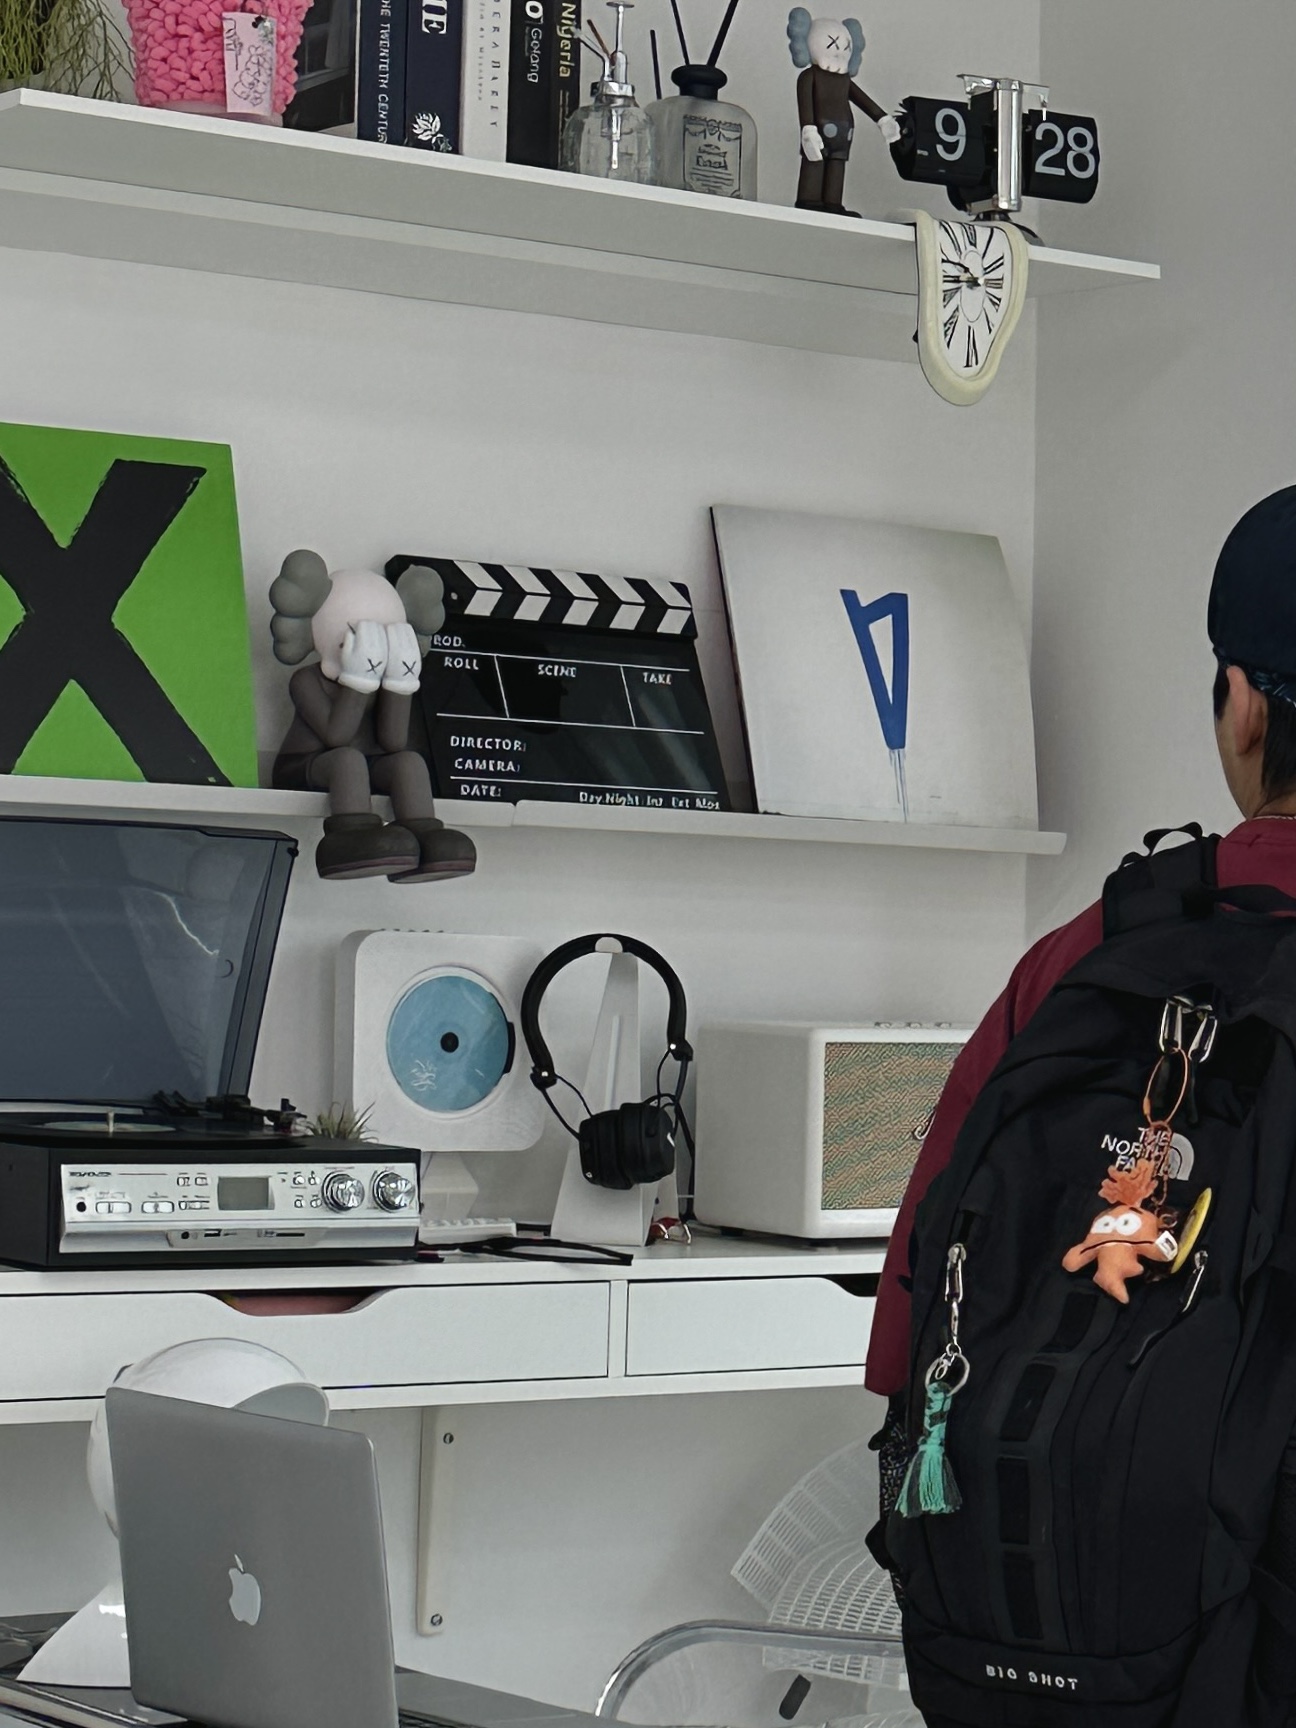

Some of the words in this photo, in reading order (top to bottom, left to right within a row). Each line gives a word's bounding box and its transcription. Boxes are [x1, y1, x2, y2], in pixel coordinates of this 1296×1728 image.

[935, 107, 967, 161] 9
[1035, 122, 1096, 180] 28
[444, 656, 479, 671] ROLL
